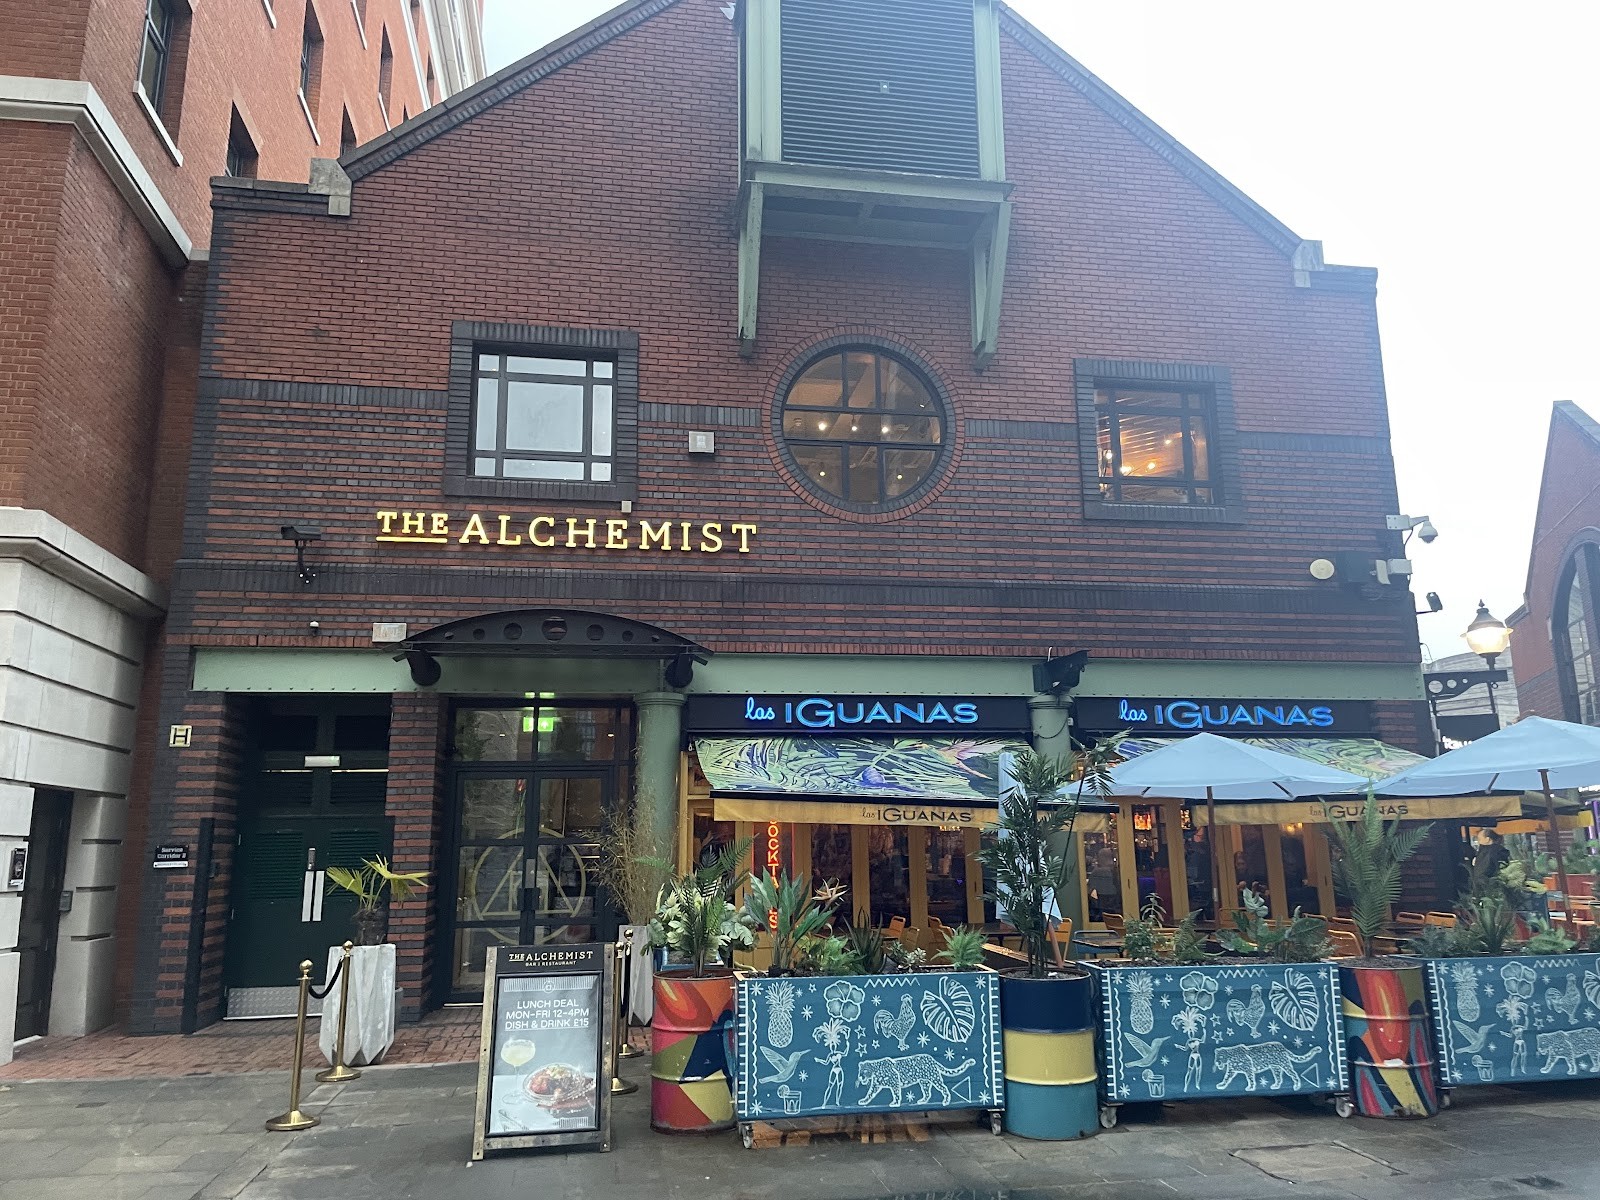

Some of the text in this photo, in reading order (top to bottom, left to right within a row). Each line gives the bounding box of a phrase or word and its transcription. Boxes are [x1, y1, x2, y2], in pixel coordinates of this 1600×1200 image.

[376, 510, 757, 553] THE ALCHEMIST
[744, 696, 979, 728] las IGUANAS
[1119, 699, 1334, 729] las IGUANAS
[173, 727, 188, 744] H
[862, 807, 972, 823] las IGUANAS
[767, 819, 780, 929] OCKTS
[526, 951, 594, 961] ALCHEMIST
[517, 999, 579, 1010] LUNCH DEAL
[506, 1008, 590, 1020] MON-FRI 12-4PM
[505, 1018, 589, 1030] DISH & DRINK £15
